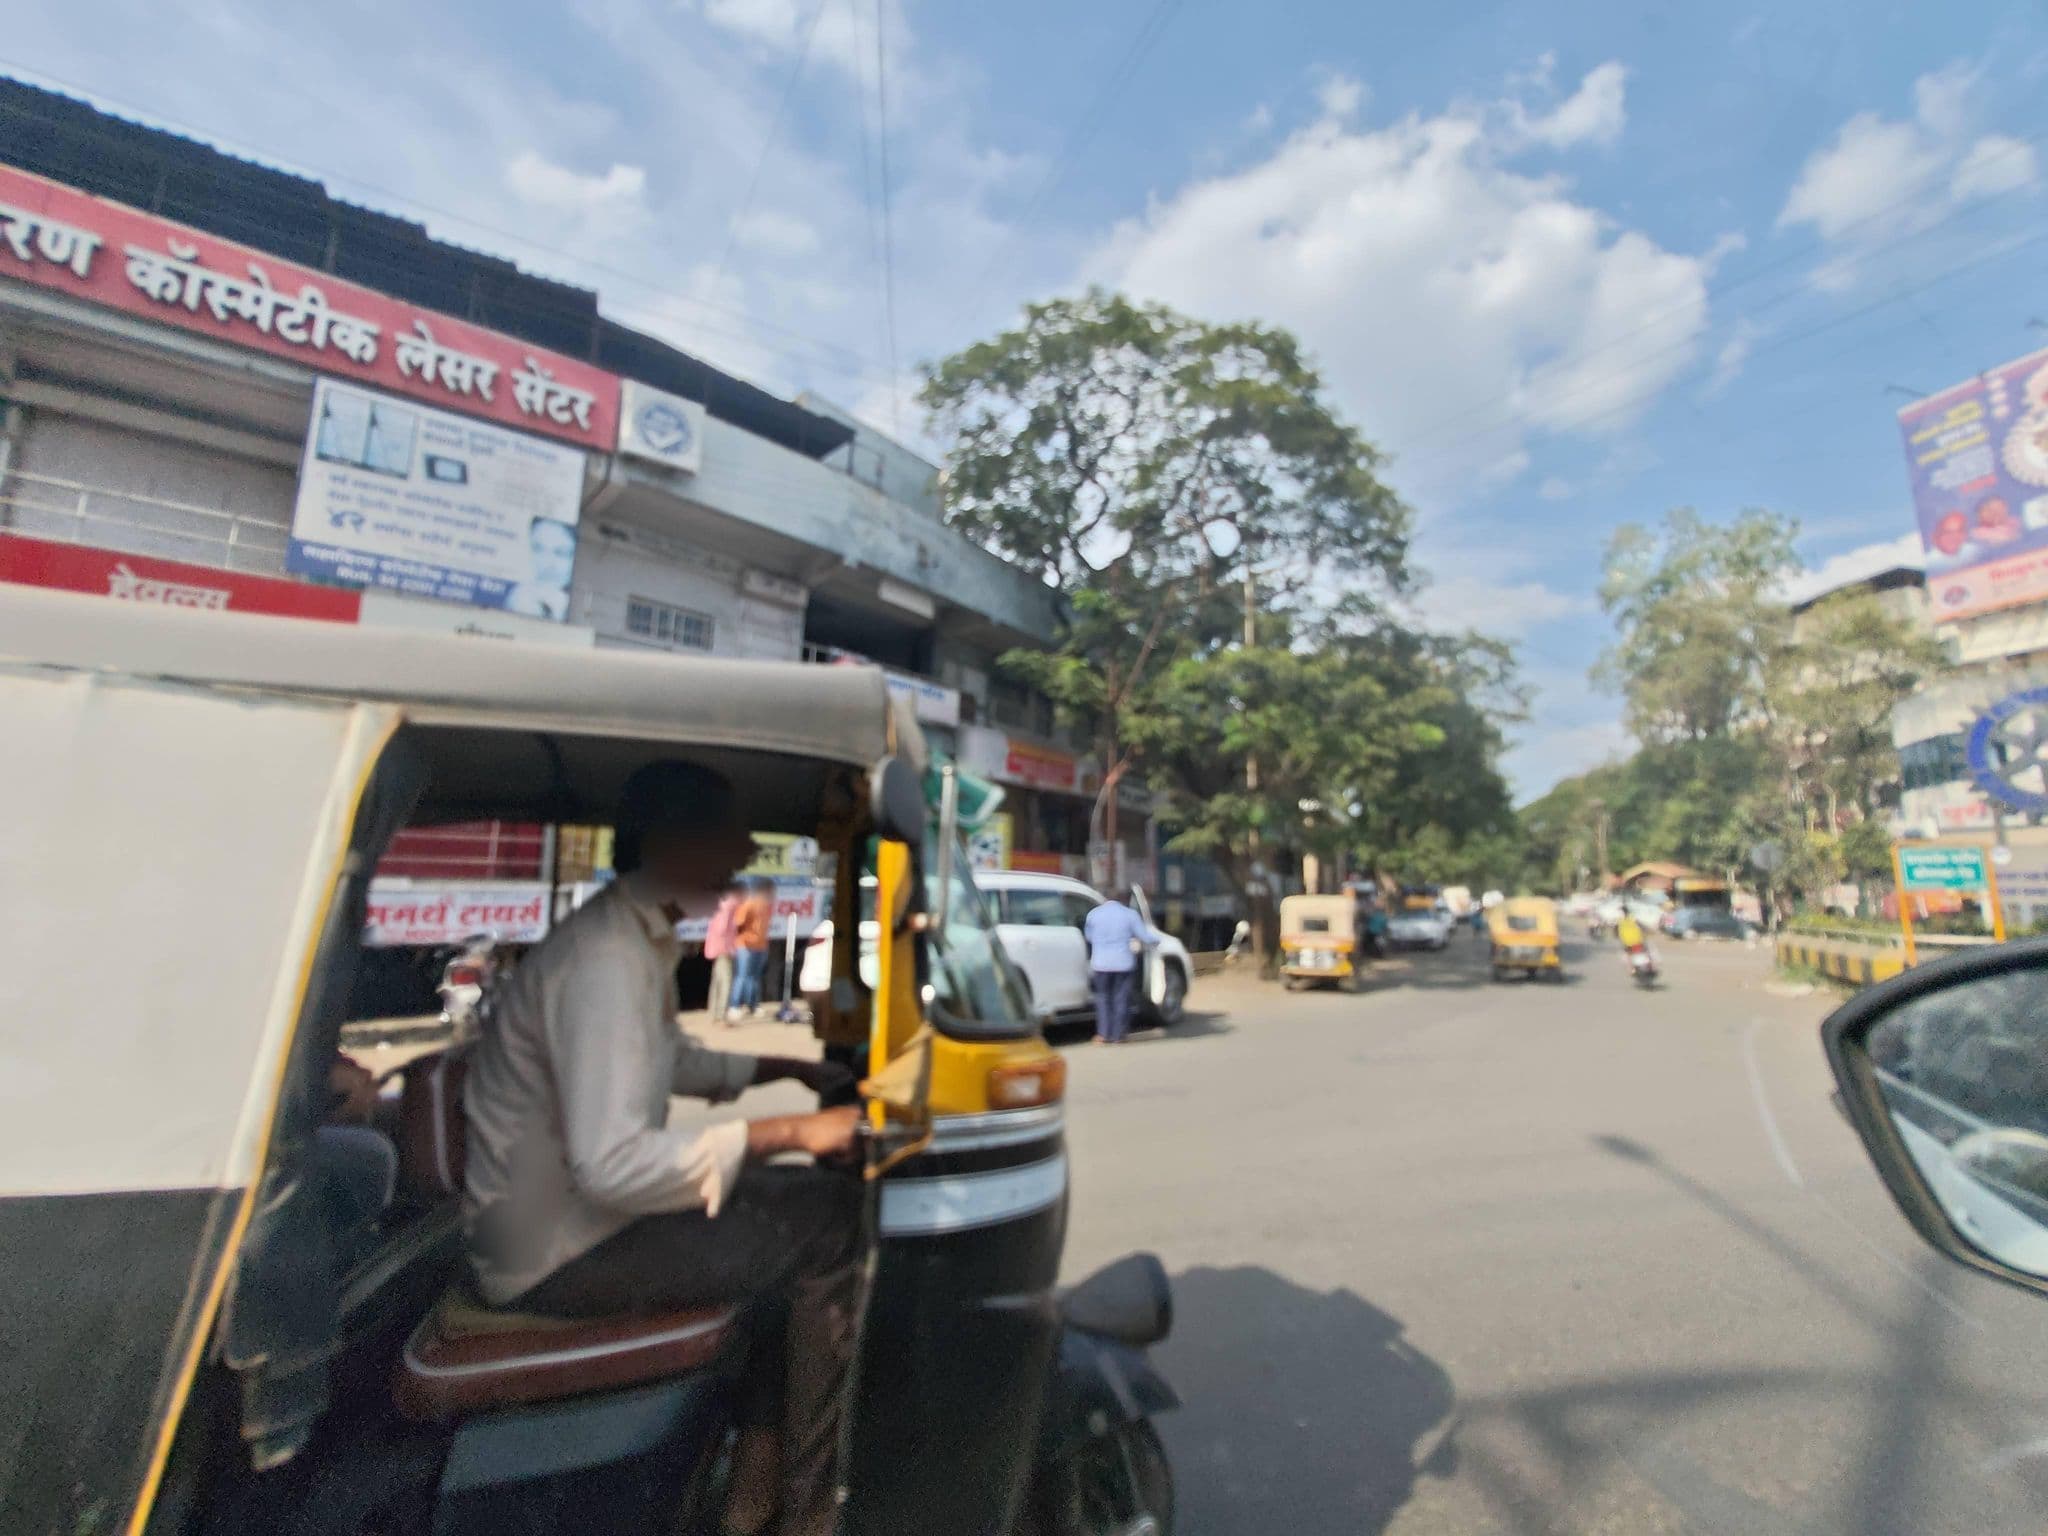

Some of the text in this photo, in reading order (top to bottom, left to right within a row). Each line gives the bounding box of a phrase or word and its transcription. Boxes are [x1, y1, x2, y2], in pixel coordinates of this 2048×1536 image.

[0, 204, 597, 431] रण कॉस्मेटीक लेसर सेंटर
